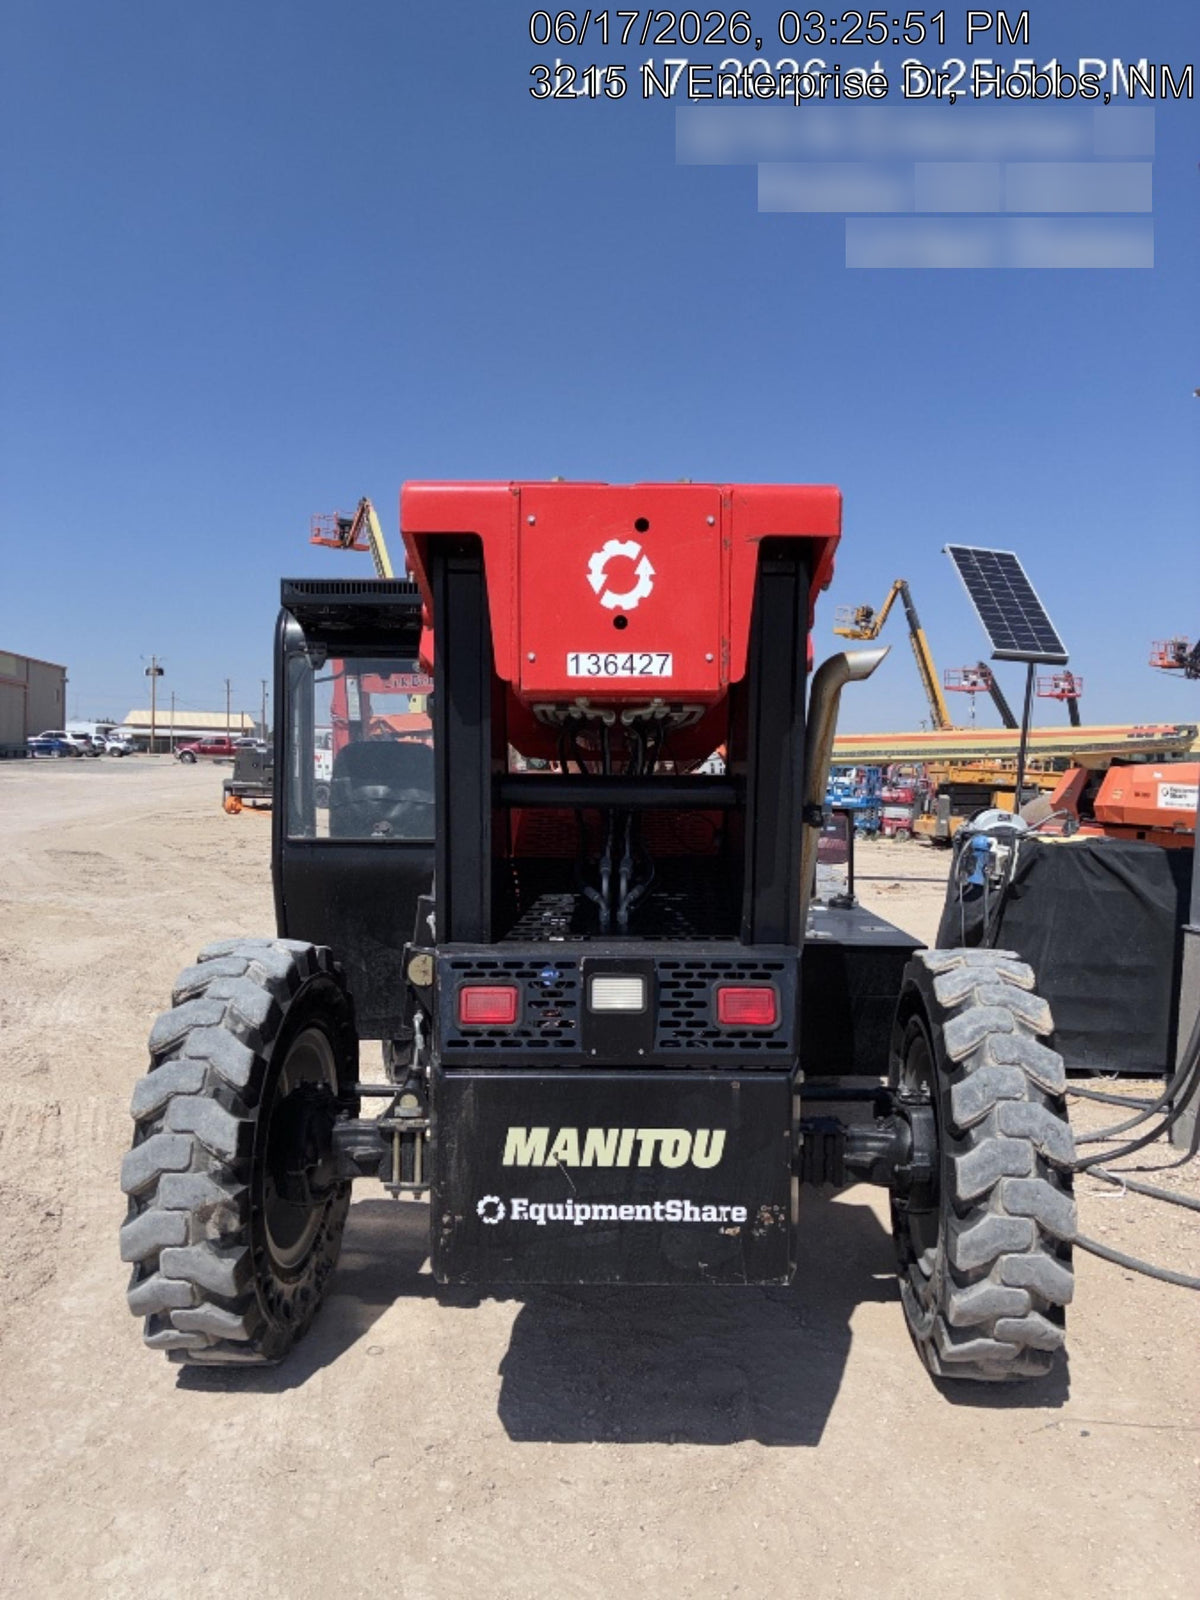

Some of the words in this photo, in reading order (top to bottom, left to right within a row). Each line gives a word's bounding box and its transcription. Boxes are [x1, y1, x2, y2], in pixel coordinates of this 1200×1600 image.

[570, 653, 671, 676] 136427
[502, 1127, 726, 1169] MANITOU
[509, 1198, 748, 1226] EquipmentShare
